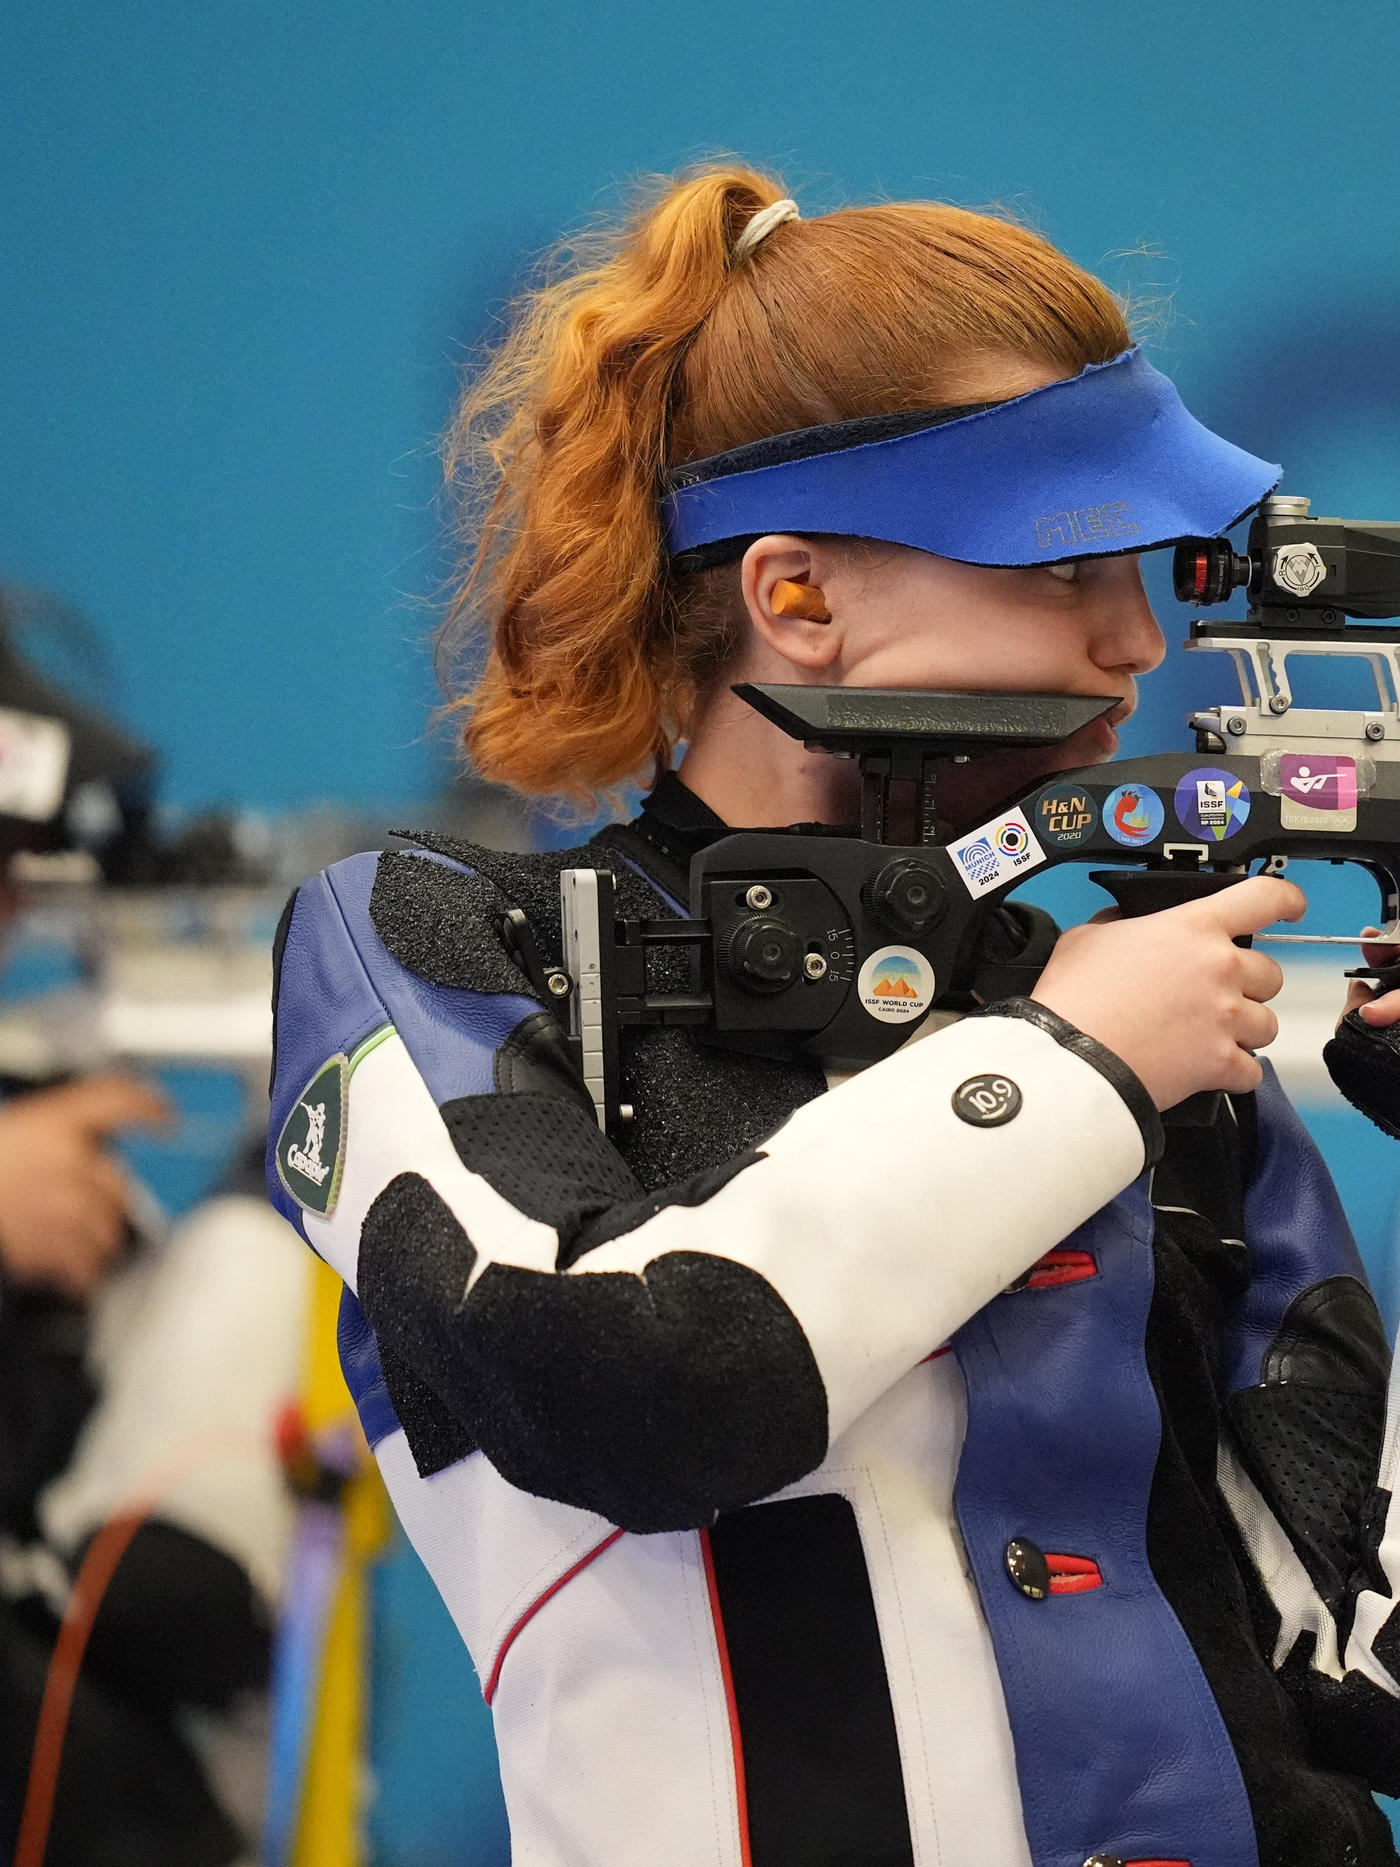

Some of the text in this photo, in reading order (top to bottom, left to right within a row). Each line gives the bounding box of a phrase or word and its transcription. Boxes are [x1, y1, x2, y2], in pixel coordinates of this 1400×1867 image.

[1035, 501, 1141, 548] MEC
[1042, 796, 1086, 815] H&N
[1200, 800, 1223, 808] ISSF
[1048, 813, 1092, 832] CUP
[1310, 816, 1328, 824] 2020
[1057, 832, 1082, 841] 2020
[964, 851, 996, 872] MUNICH
[1013, 852, 1031, 867] ISSF
[978, 870, 1000, 886] 2024
[827, 929, 839, 941] 15
[829, 969, 840, 982] 15
